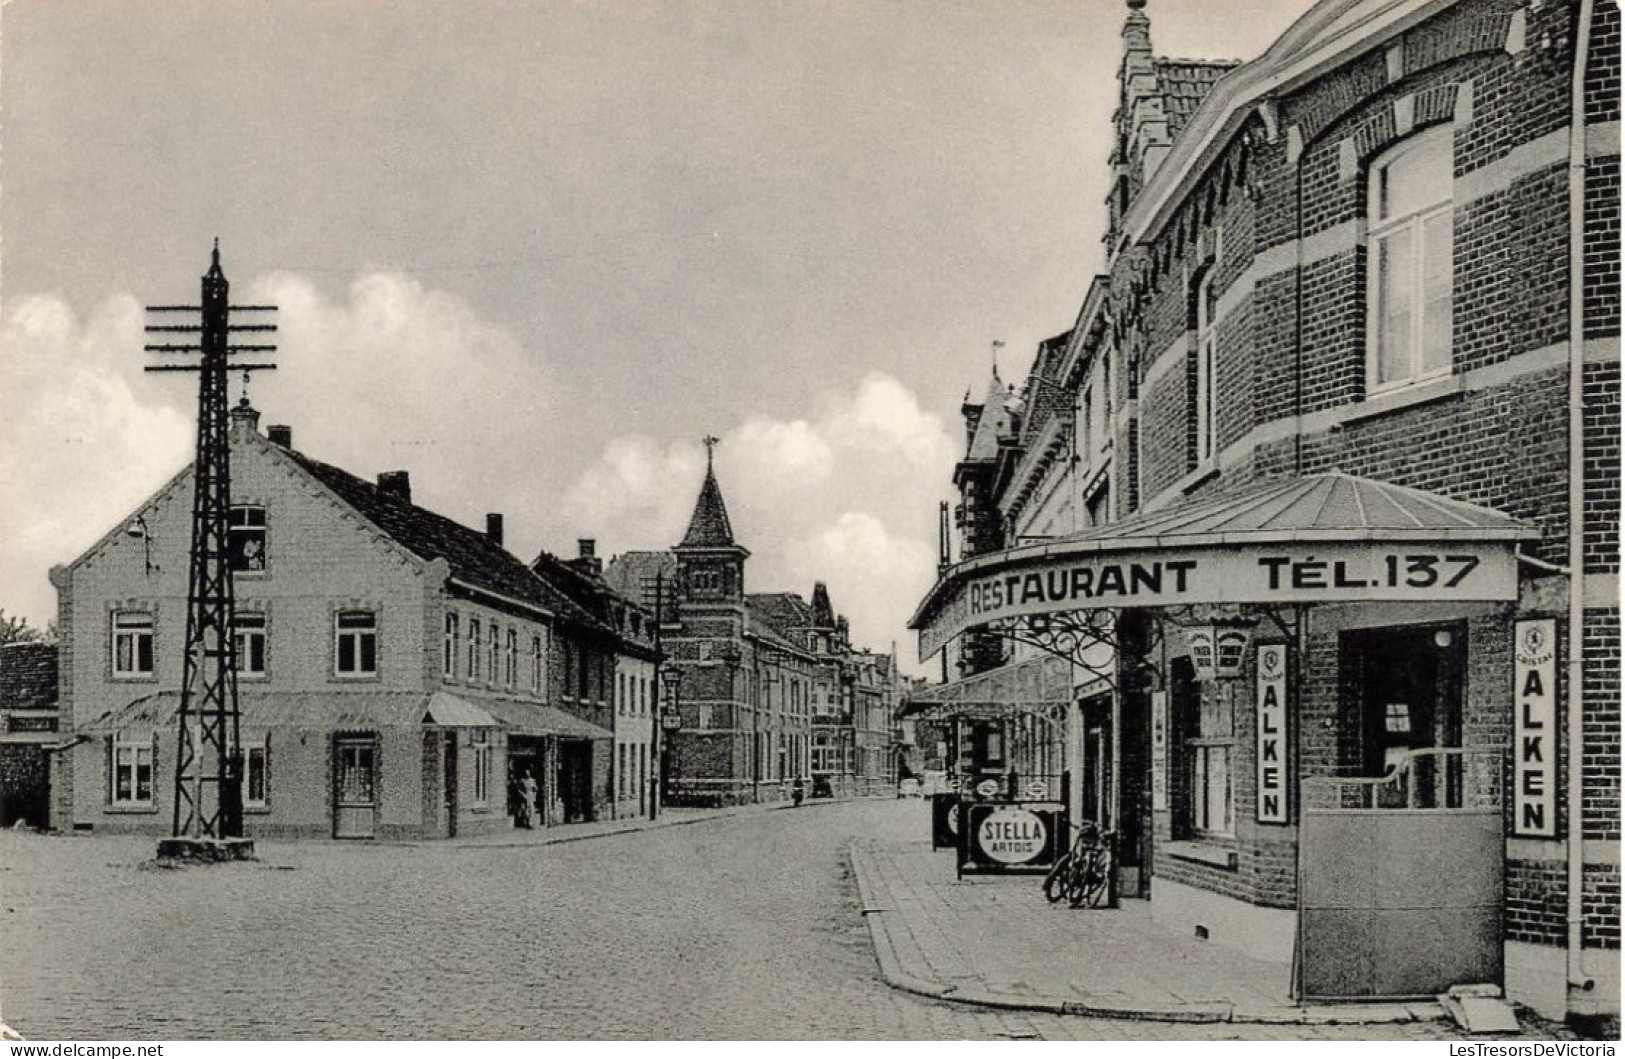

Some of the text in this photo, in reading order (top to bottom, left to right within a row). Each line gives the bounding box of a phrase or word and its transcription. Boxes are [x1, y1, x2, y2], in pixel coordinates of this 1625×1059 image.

[970, 560, 1198, 615] RESTAURANT
[1263, 685, 1279, 817] ALKEN
[1522, 669, 1544, 829] ALKEN
[985, 822, 1042, 840] STELLA
[992, 842, 1033, 853] ARTOIS
